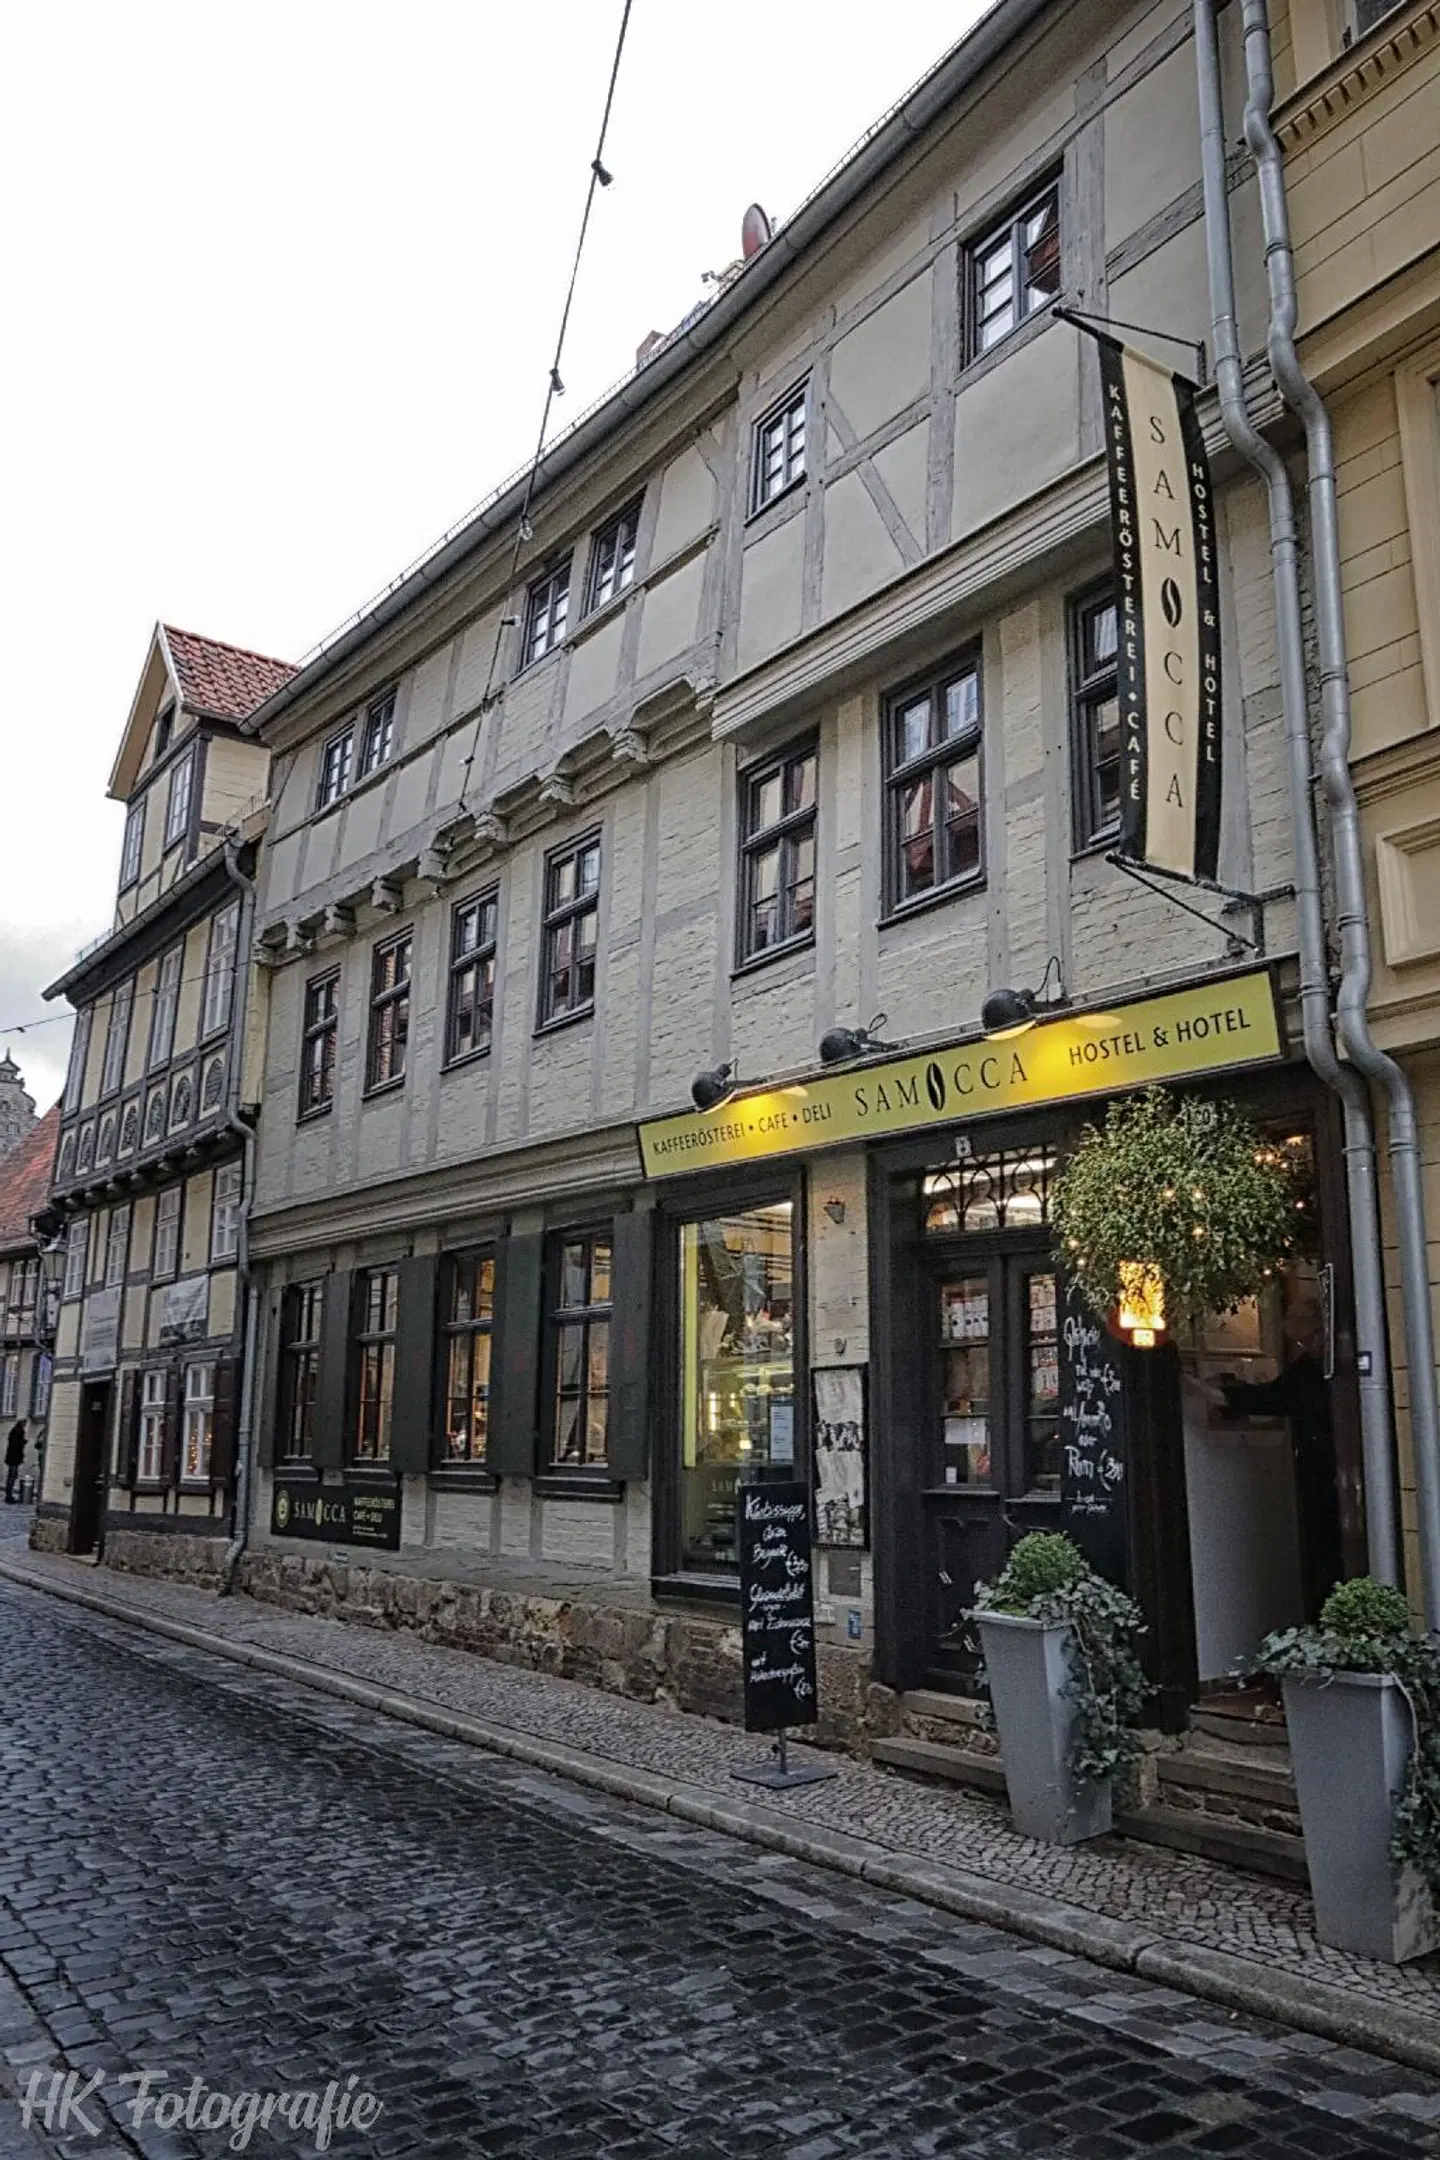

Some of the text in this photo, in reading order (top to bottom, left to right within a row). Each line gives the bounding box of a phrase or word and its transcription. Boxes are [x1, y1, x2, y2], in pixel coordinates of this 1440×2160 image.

[1108, 384, 1140, 800] KAFFEERÖSTEREI CAFÉ
[1192, 463, 1217, 763] HOSTEL & HOTEL
[1068, 1008, 1252, 1066] HOSTEL & HOTEL
[652, 1122, 745, 1156] KAFFEERÖSTEREI
[802, 1102, 831, 1124] DELI
